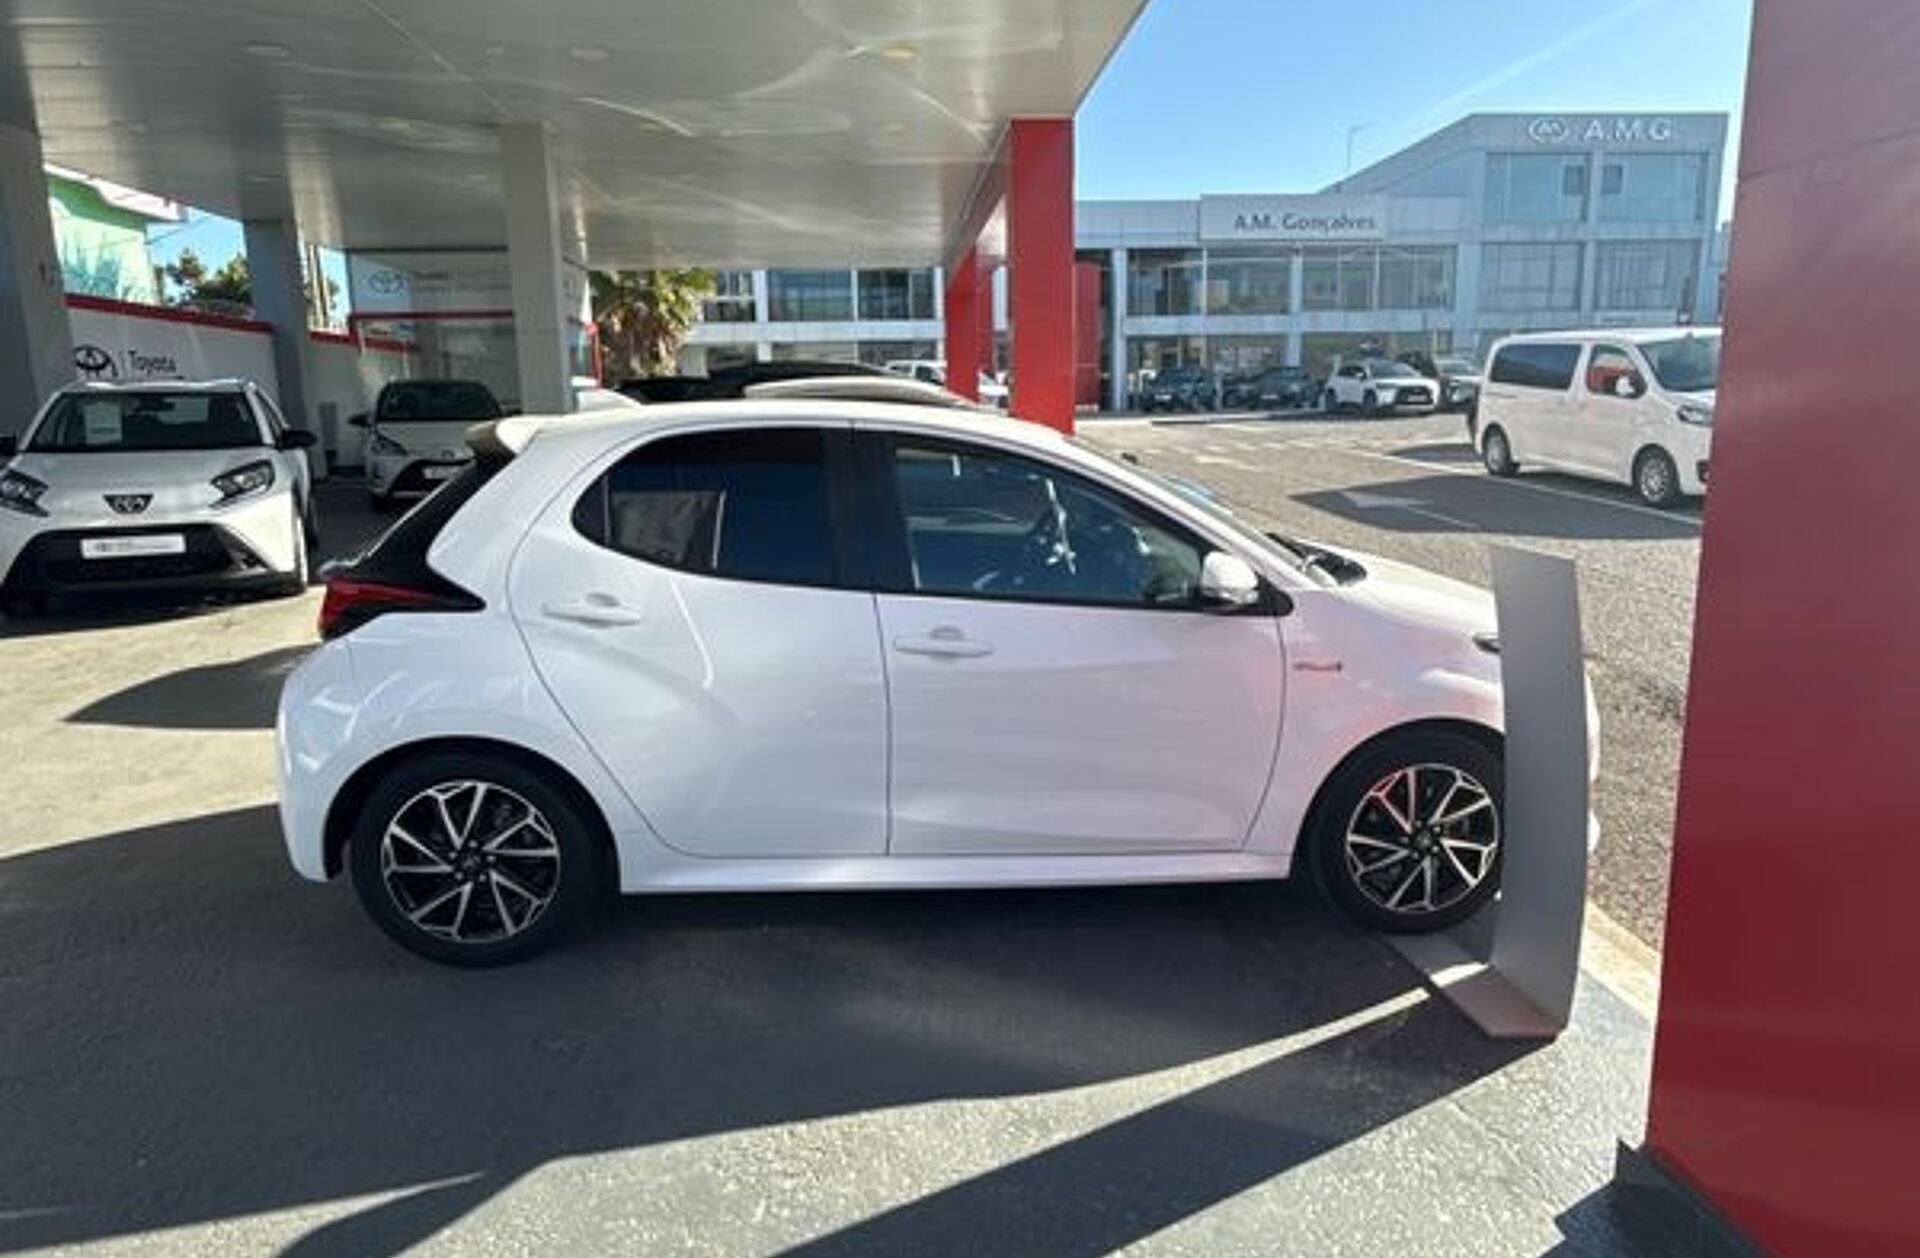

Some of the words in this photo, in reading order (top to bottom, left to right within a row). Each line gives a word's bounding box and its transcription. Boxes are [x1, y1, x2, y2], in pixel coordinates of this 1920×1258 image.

[1234, 213, 1276, 230] A.M.
[1282, 212, 1376, 234] Gonçalves
[128, 349, 177, 376] Toyota
